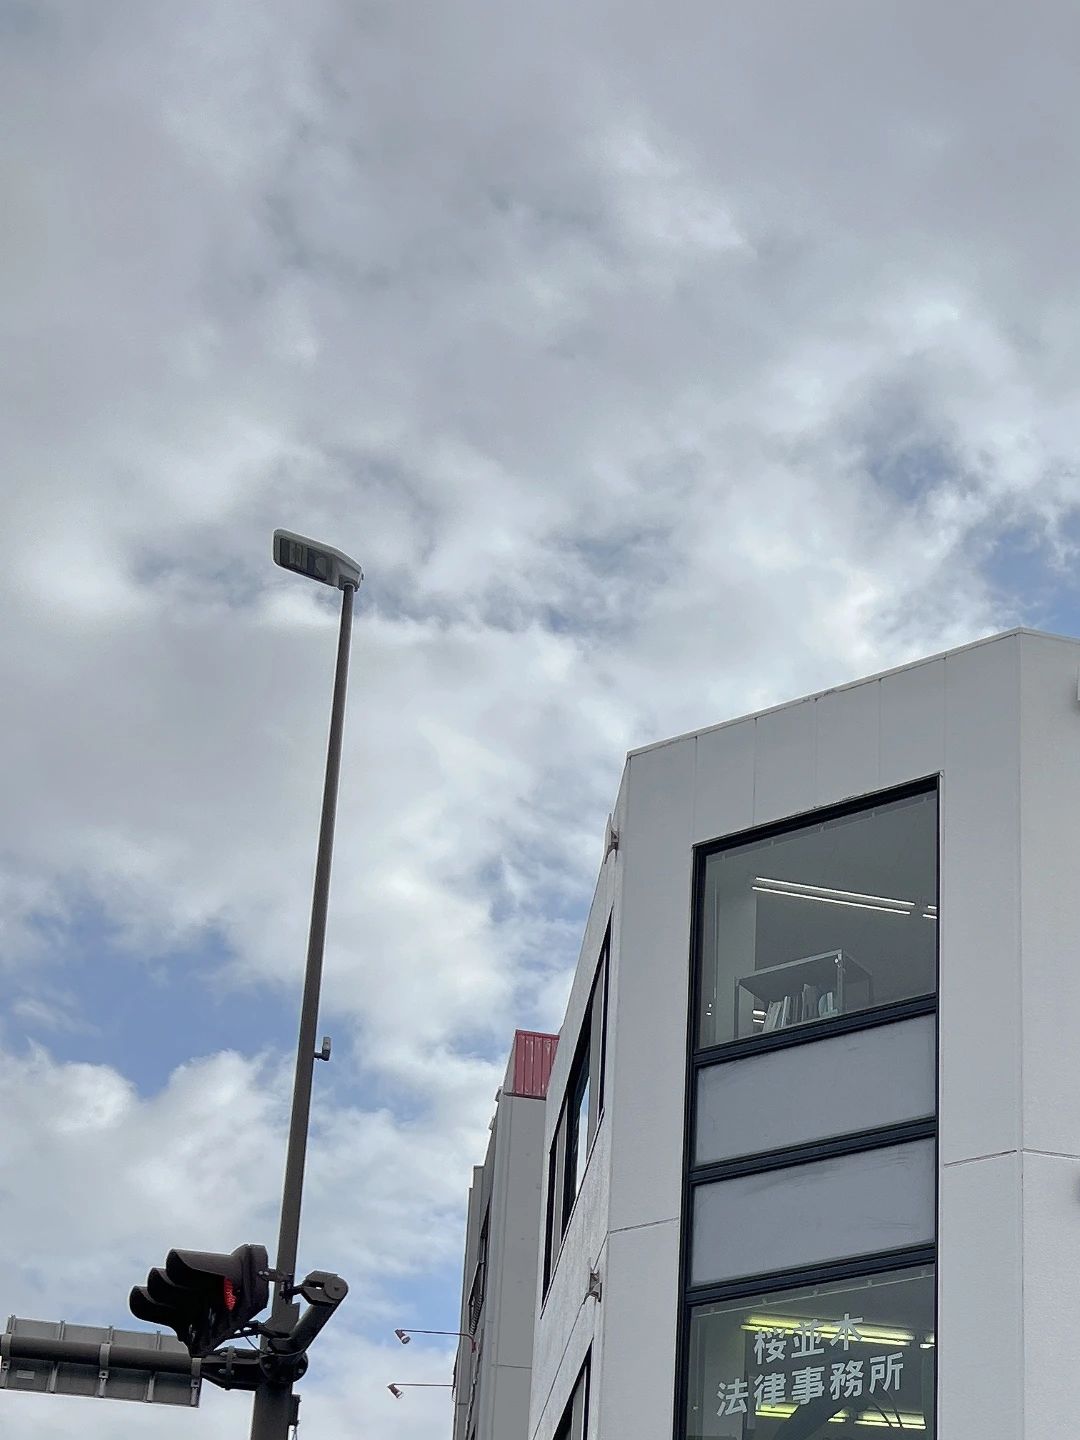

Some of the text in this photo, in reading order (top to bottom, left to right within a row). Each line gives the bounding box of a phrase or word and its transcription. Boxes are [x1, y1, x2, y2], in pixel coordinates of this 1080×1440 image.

[754, 1313, 864, 1364] 桜並木
[716, 1352, 904, 1417] 法律事務所
